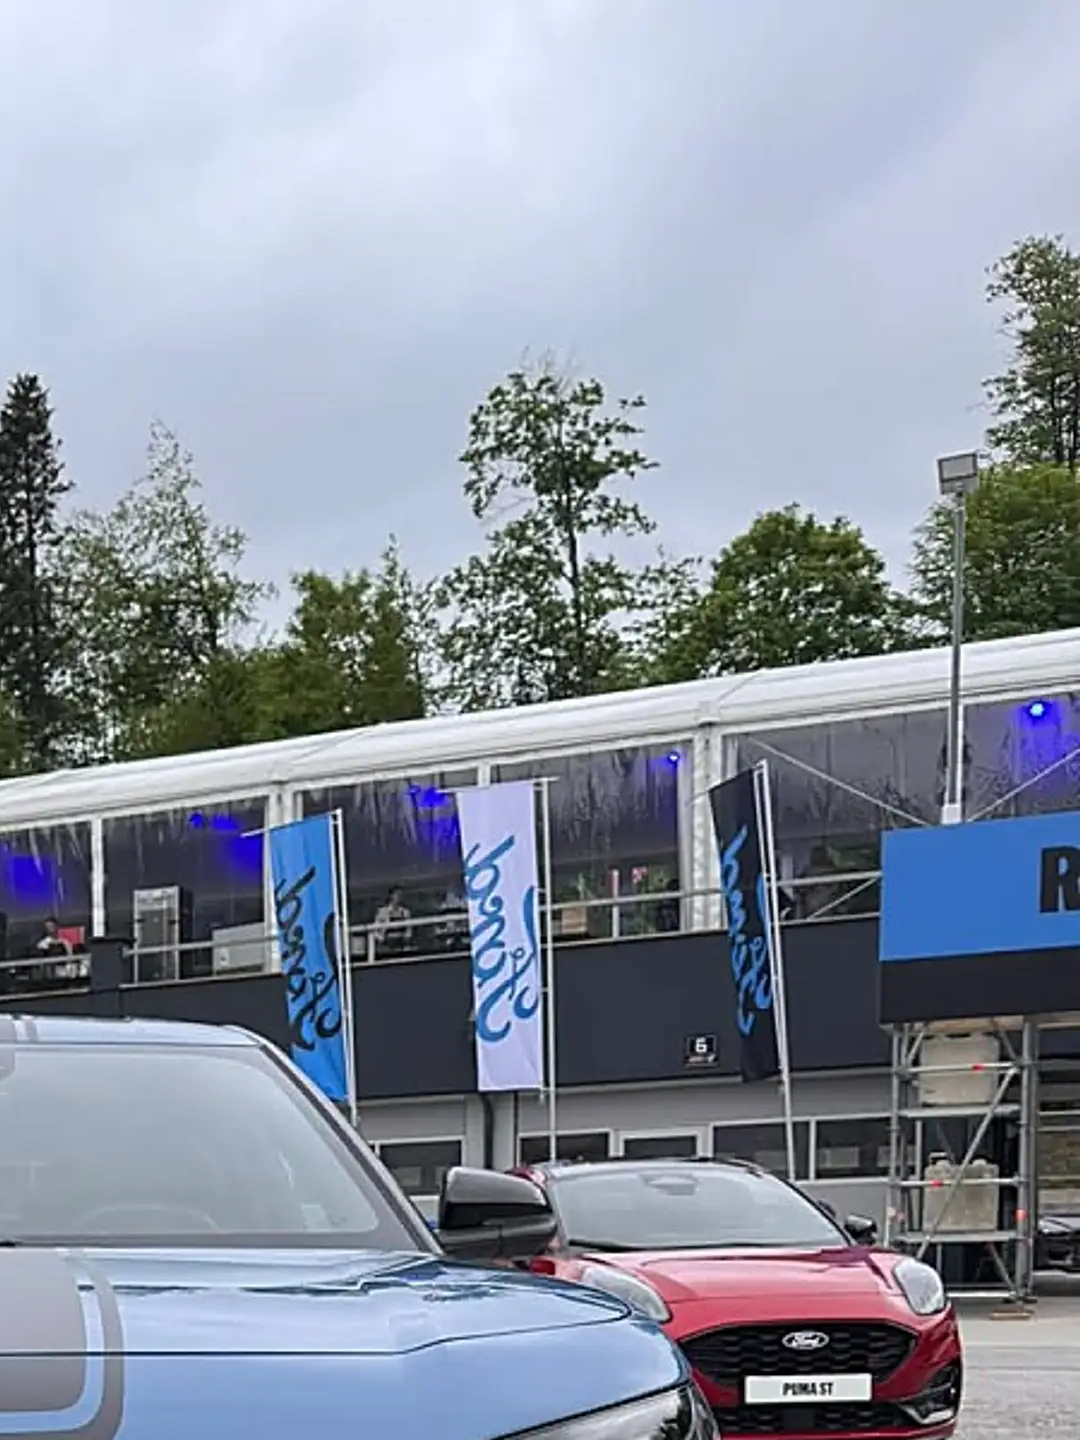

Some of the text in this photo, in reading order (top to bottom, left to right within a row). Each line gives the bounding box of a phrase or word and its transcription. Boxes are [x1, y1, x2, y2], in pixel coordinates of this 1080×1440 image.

[696, 1037, 707, 1052] 6
[783, 1382, 834, 1396] PUMA ST
